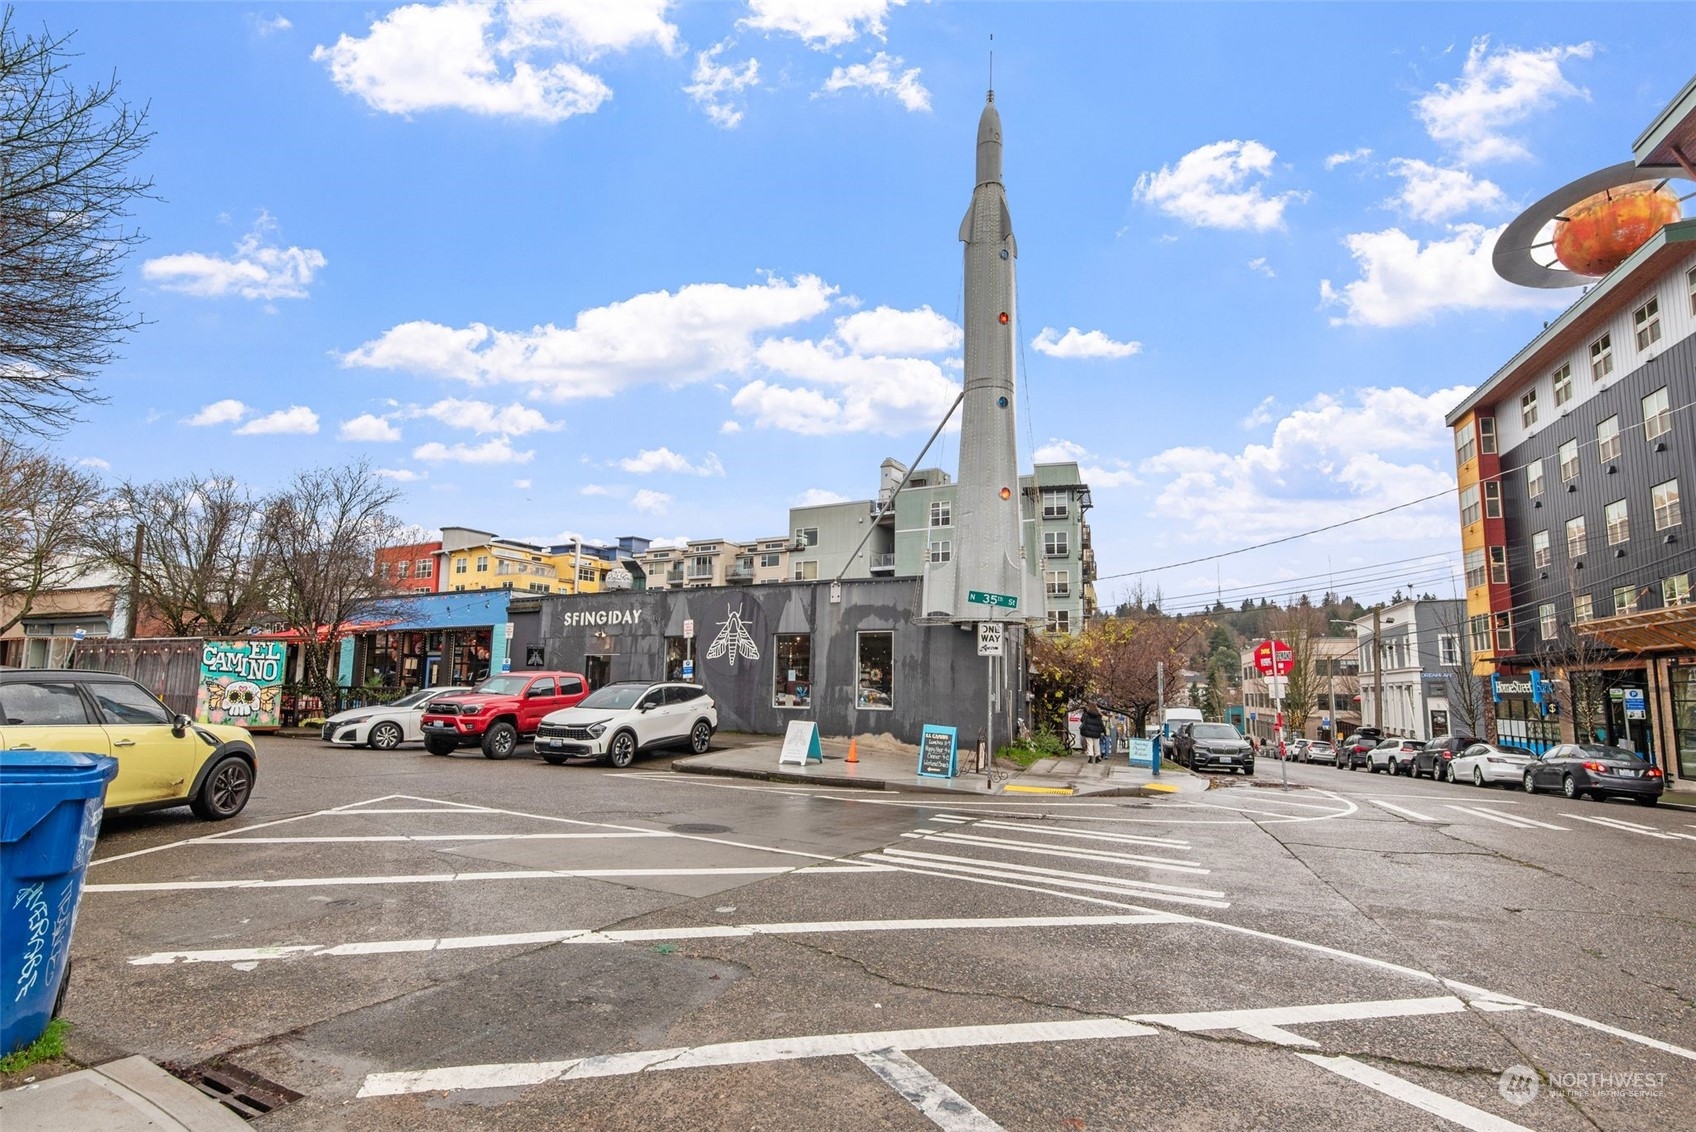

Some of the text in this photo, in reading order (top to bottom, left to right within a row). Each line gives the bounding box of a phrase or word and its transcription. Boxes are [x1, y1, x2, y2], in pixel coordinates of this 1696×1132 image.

[983, 594, 1003, 605] 35th
[1008, 598, 1016, 606] St
[564, 609, 642, 626] SFINGIDAY
[981, 634, 1001, 642] WAY
[249, 641, 280, 660] EL
[203, 647, 278, 681] CAMINO
[1495, 680, 1533, 693] HomeStreet
